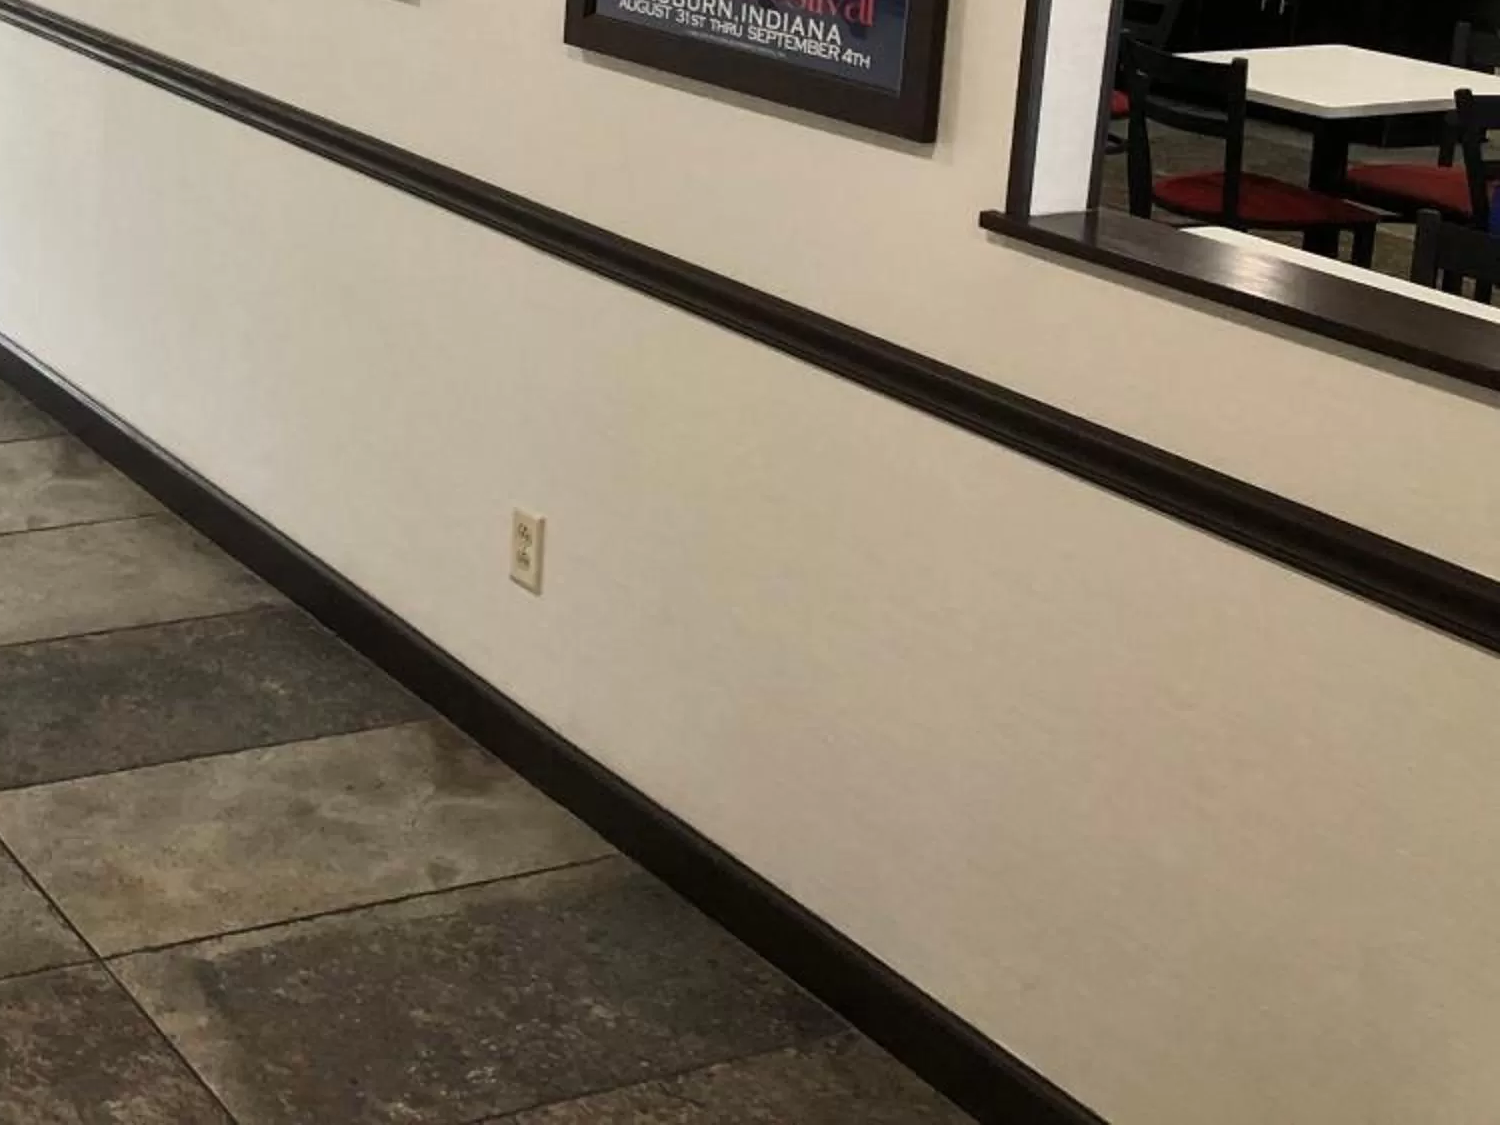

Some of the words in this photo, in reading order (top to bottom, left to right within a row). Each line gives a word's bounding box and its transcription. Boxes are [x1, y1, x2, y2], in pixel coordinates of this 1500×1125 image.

[675, 8, 706, 29] 31ST
[710, 18, 743, 41] THRU
[747, 26, 841, 63] SEPTEMBER
[841, 48, 871, 70] 4TH
